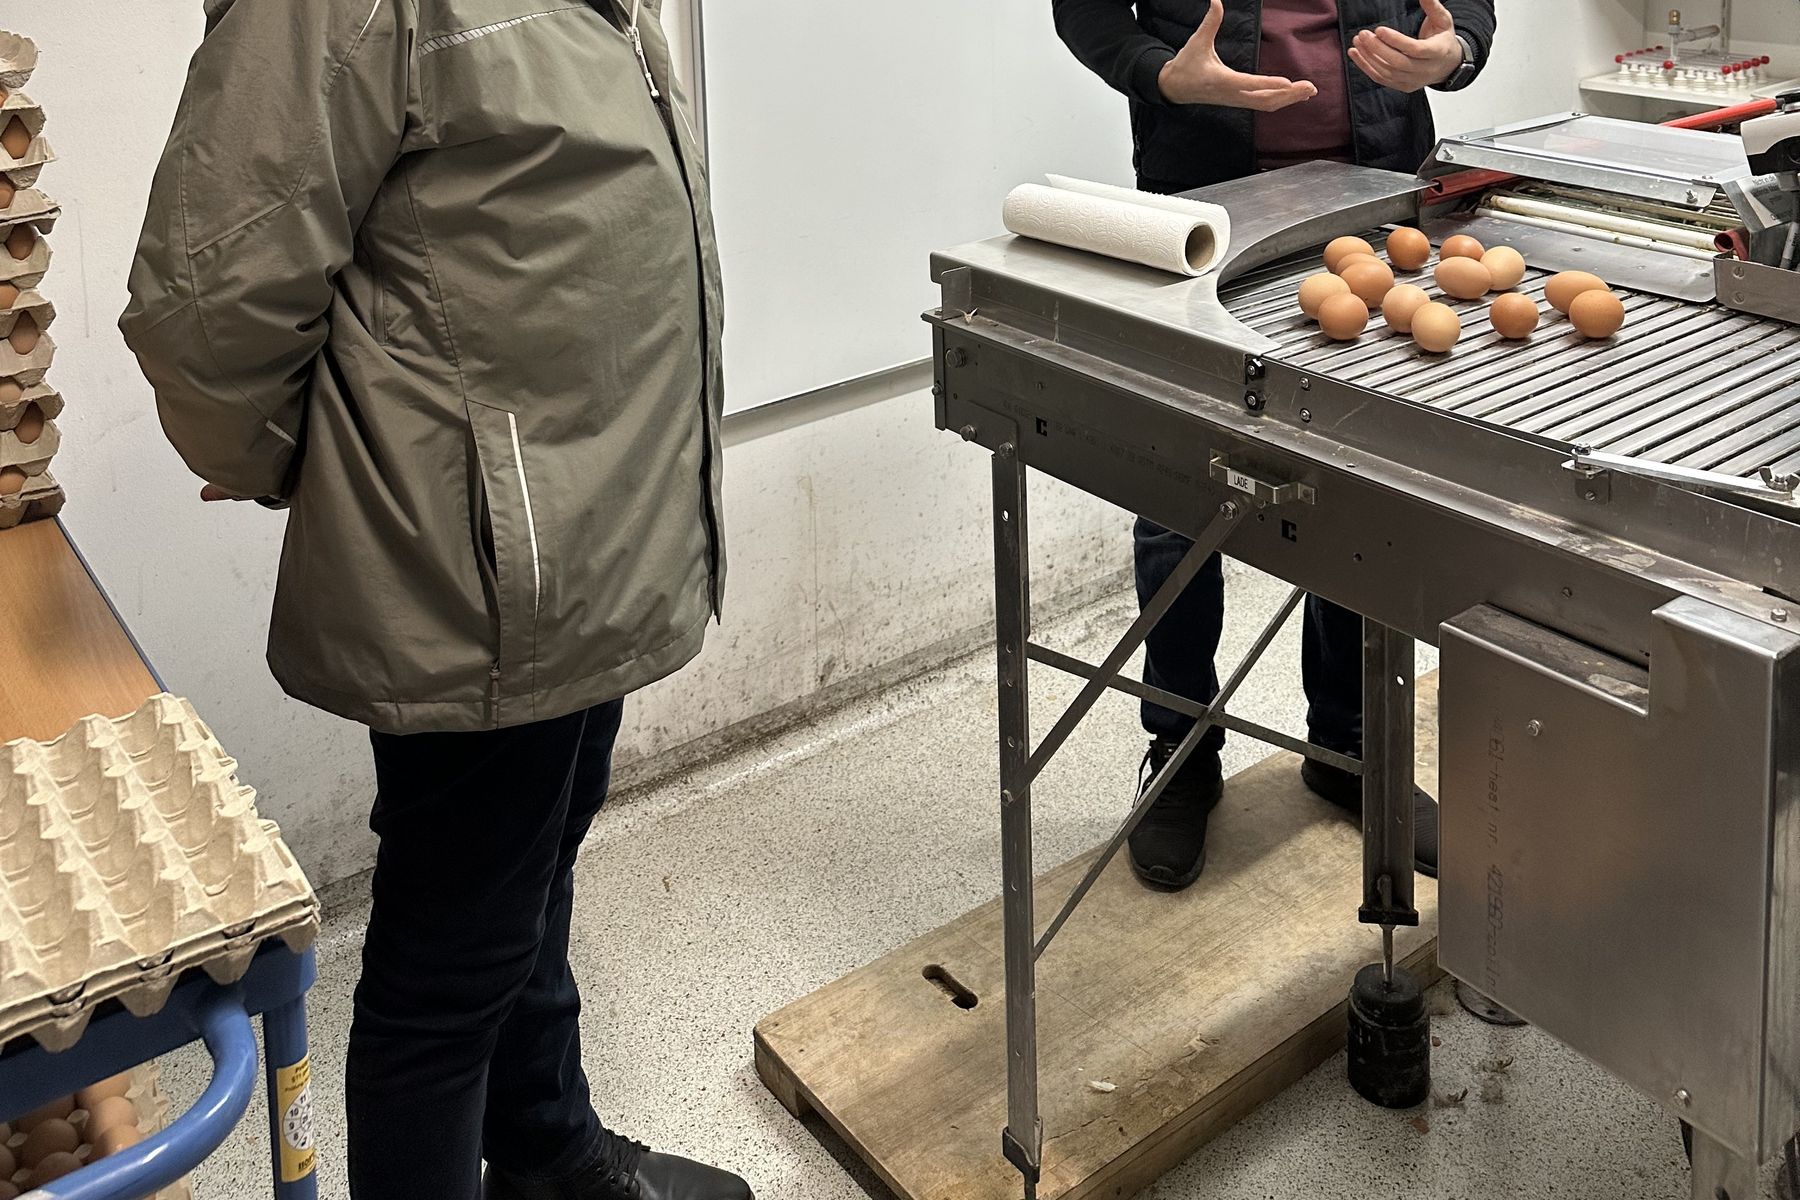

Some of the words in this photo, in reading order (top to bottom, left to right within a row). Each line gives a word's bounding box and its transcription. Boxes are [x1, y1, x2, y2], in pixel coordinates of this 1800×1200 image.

[1233, 473, 1248, 490] LADE
[289, 1108, 299, 1118] 10
[289, 1121, 295, 1130] 9
